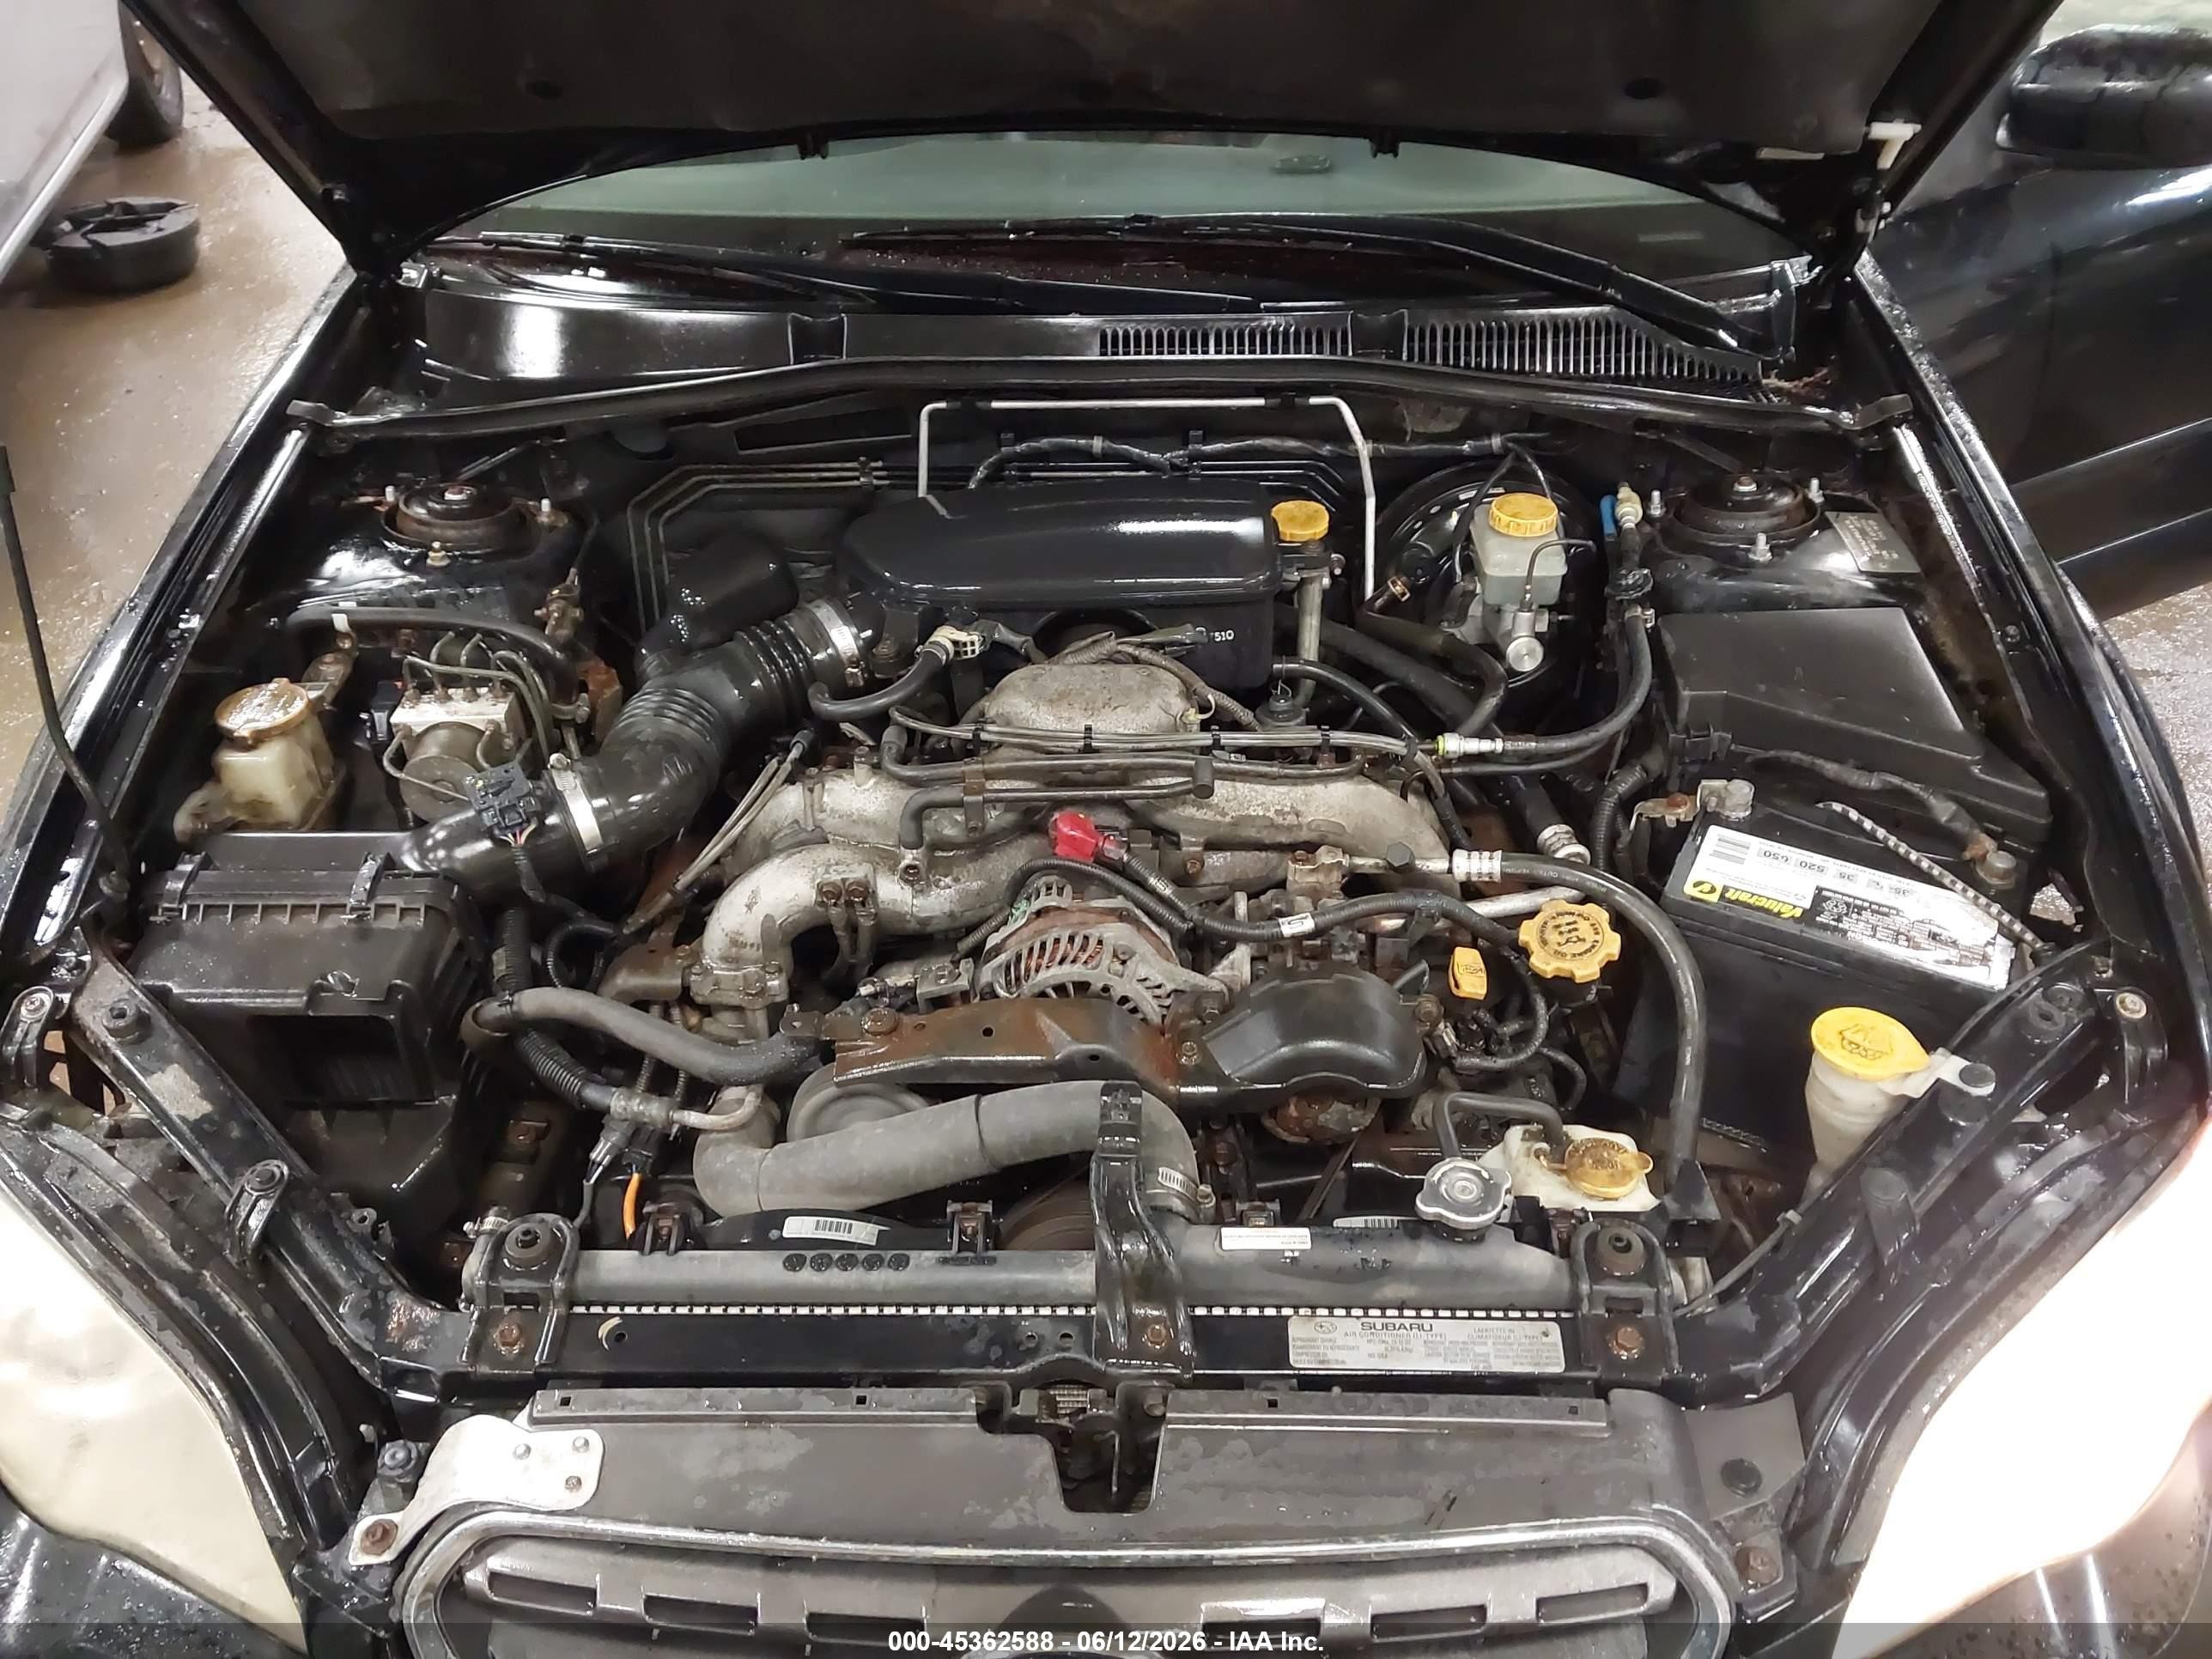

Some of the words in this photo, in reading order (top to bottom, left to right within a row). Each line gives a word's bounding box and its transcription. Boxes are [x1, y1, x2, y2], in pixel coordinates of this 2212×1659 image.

[1763, 849, 1789, 863] 650
[1799, 860, 1826, 873] 520
[1723, 885, 1804, 919] Valucraft
[1360, 1322, 1433, 1333] SUBARU
